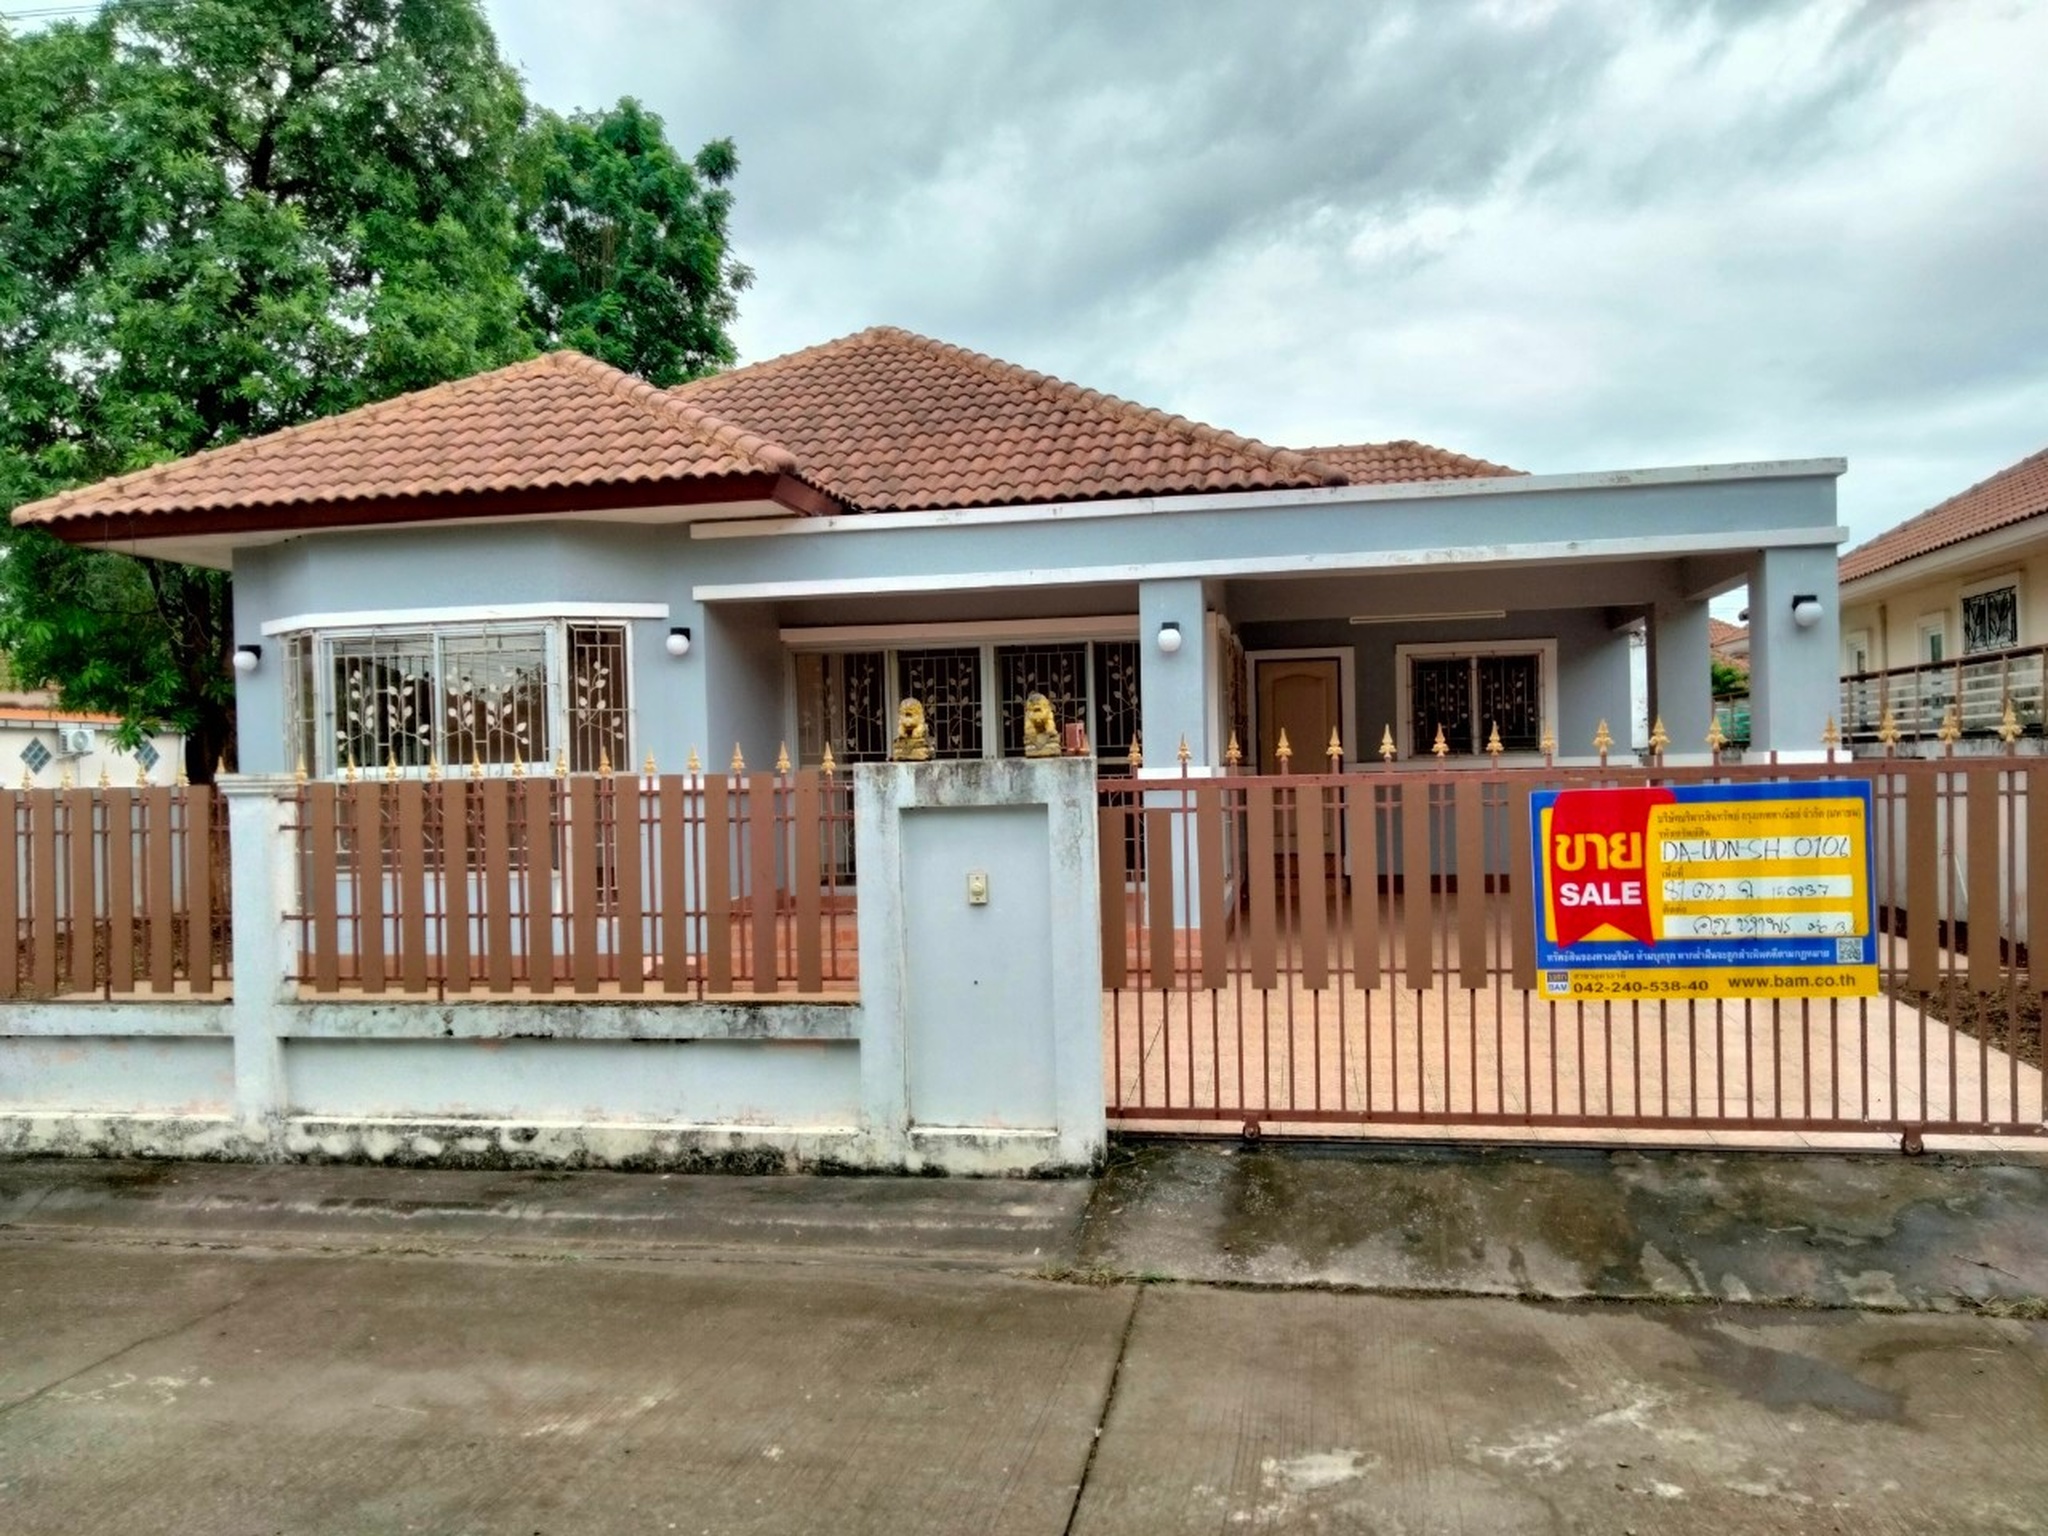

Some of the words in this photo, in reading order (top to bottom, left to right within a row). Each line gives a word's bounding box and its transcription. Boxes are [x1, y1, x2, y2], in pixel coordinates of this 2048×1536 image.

[1555, 831, 1642, 871] ขาย
[1559, 881, 1642, 907] SALE
[1573, 980, 1709, 994] 042-240-538-40
[1728, 973, 1856, 988] www.bam.co.th
